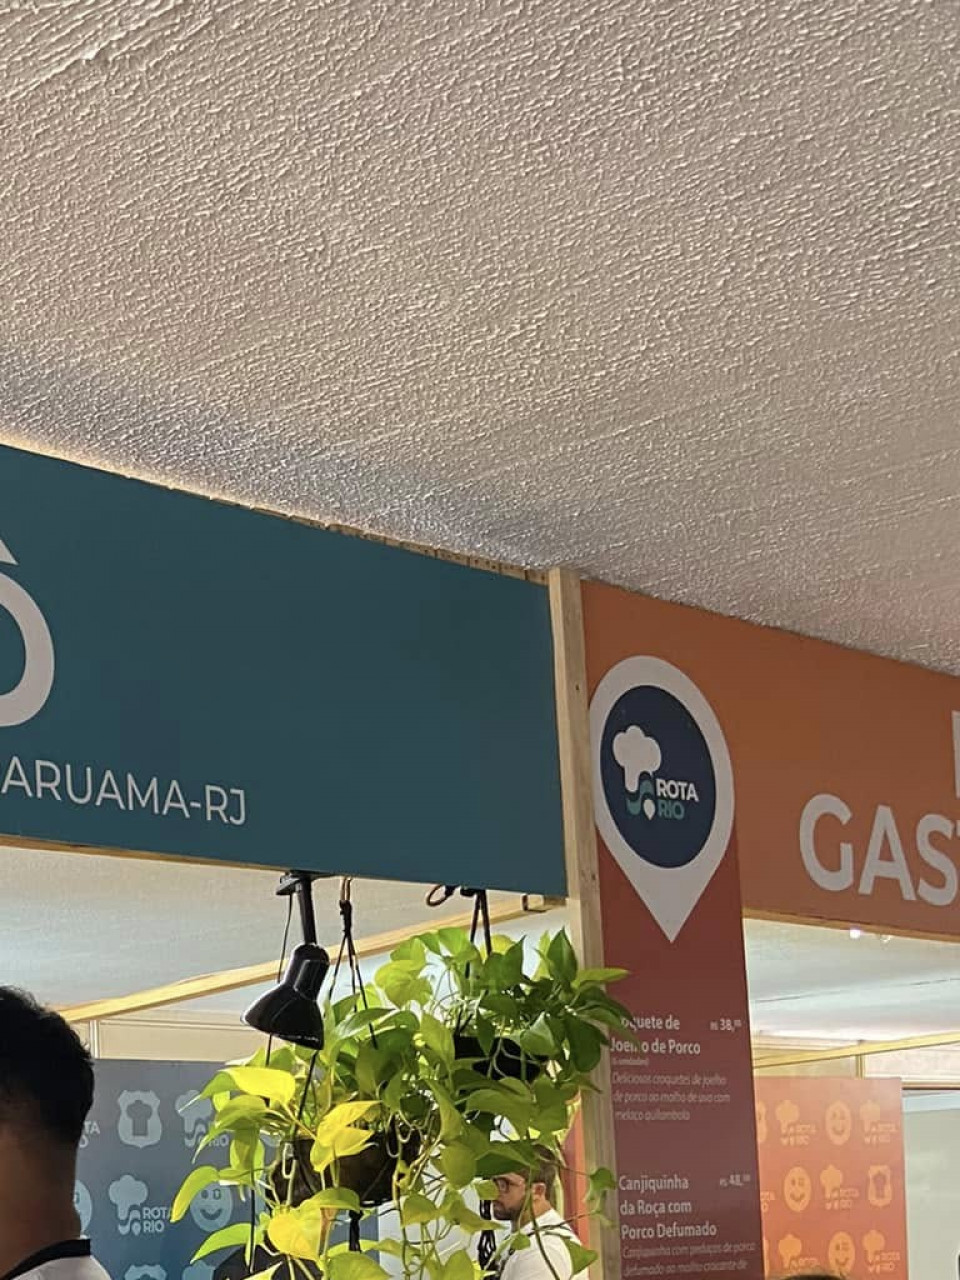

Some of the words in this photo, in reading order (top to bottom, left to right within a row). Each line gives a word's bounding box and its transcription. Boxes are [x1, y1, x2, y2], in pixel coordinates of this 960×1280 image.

[656, 778, 700, 802] ROTA
[657, 799, 685, 820] RIO
[799, 793, 960, 906] GAS
[665, 1014, 681, 1031] de
[651, 1037, 667, 1053] de
[668, 1039, 701, 1055] Porco
[84, 1121, 101, 1135] TA
[618, 1174, 690, 1194] Canjiquinha
[620, 1200, 636, 1216] da
[638, 1200, 666, 1219] Roça
[668, 1202, 691, 1215] com
[143, 1220, 165, 1233] RIO
[621, 1224, 655, 1240] Porco
[657, 1221, 718, 1239] Defumado
